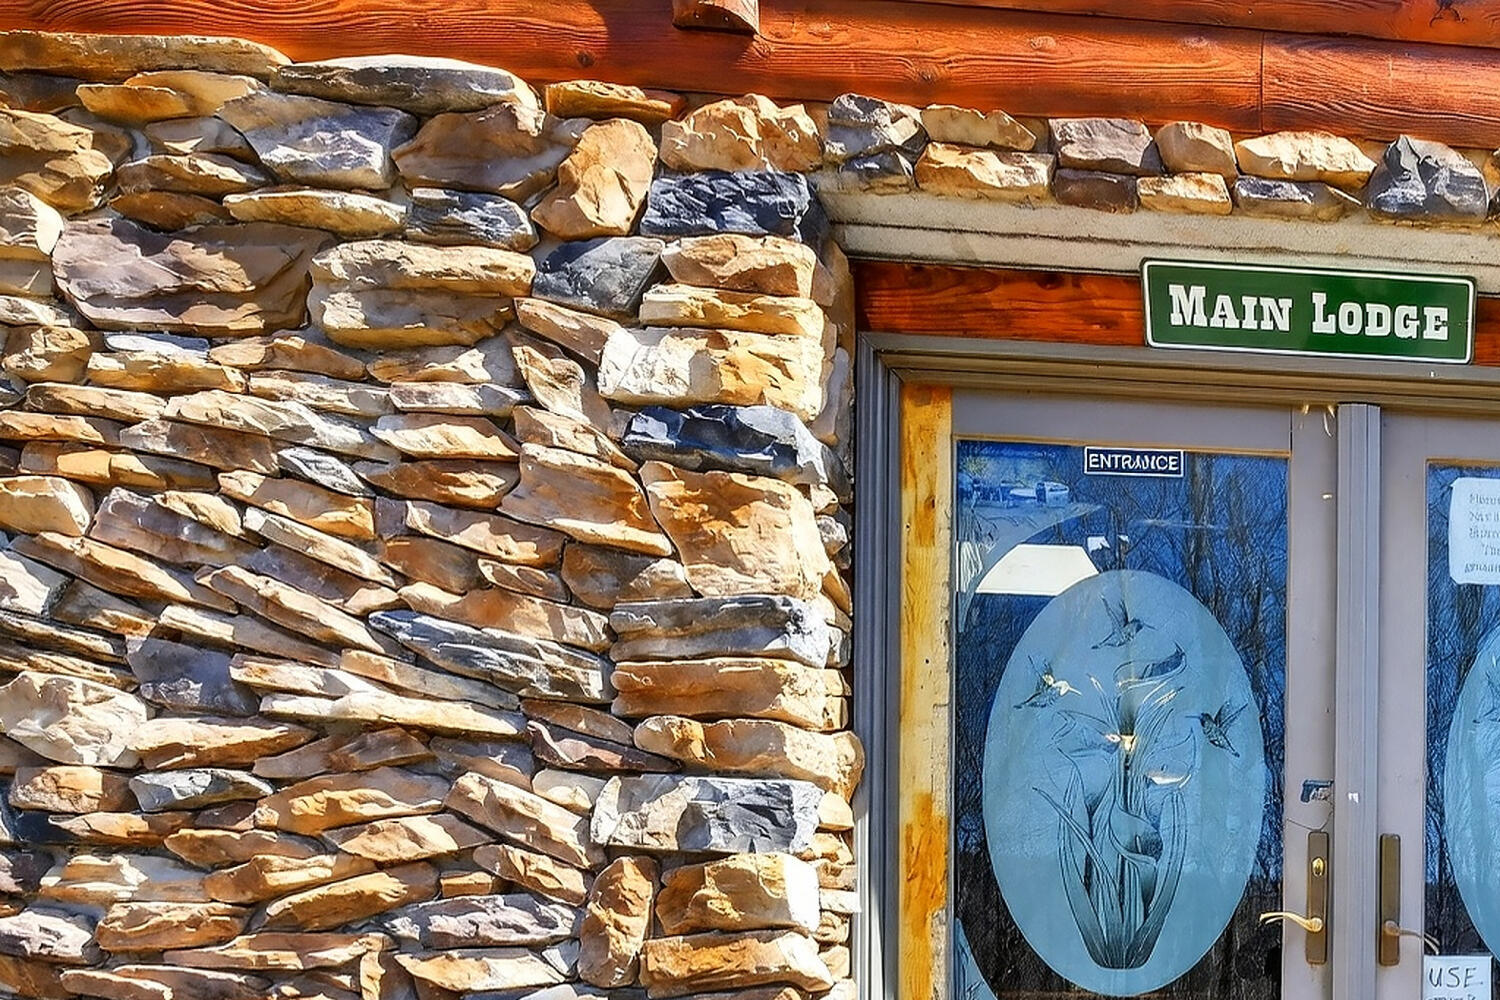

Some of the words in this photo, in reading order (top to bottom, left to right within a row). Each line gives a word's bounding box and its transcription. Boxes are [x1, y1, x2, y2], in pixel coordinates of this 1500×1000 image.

[1168, 284, 1293, 332] MAIN
[1312, 291, 1449, 341] LODGE
[1088, 453, 1179, 471] ENTRANCE
[1428, 966, 1483, 988] USE
